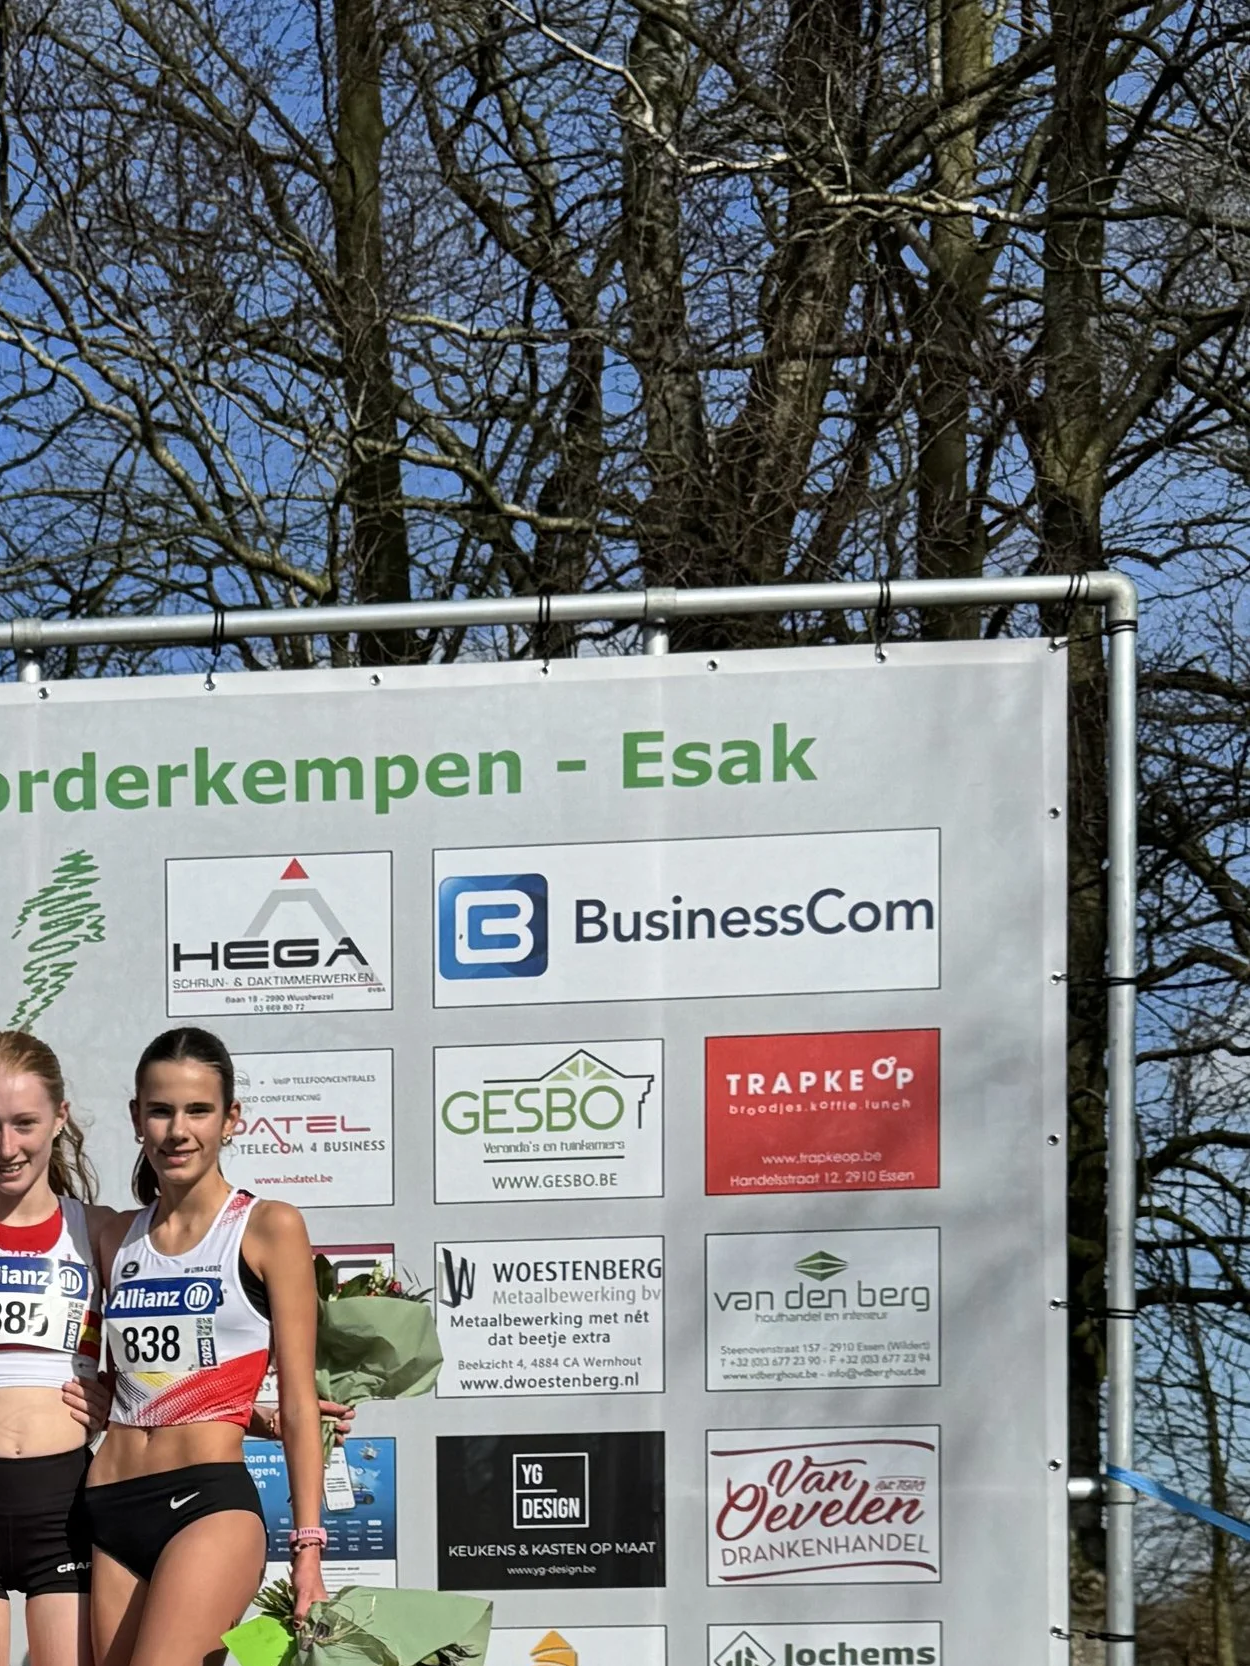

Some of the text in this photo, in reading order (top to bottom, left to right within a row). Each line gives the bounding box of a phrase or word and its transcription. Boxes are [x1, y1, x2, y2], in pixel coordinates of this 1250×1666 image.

[623, 722, 819, 790] Esak
[575, 888, 934, 944] BusinessCom
[173, 937, 369, 972] HEGA
[441, 1085, 625, 1135] GESBO
[484, 1140, 625, 1154] Veranda's en tuinkamers
[762, 1150, 881, 1166] www.trapkeop.be
[254, 1174, 333, 1185] www.indatel.be
[492, 1173, 618, 1189] WWW.GESBO.BE
[493, 1258, 662, 1283] WOESTENBERG
[110, 1287, 180, 1310] Allianz
[493, 1285, 661, 1305] Metaalbewerking bv
[714, 1280, 930, 1312] van den berg
[450, 1312, 583, 1328] Metaalbewerking
[589, 1311, 619, 1324] met
[123, 1325, 180, 1363] 838
[488, 1332, 610, 1348] dat beetje extra
[460, 1372, 639, 1390] www.dwoestenberg.nl
[522, 1464, 543, 1484] YG
[768, 1455, 867, 1498] Van
[523, 1498, 580, 1519] DESIGN
[716, 1477, 924, 1541] Oevelen
[449, 1541, 657, 1557] KEUKENS & KASTEN OP MAAT
[721, 1533, 930, 1567] DRANKENHANDEL
